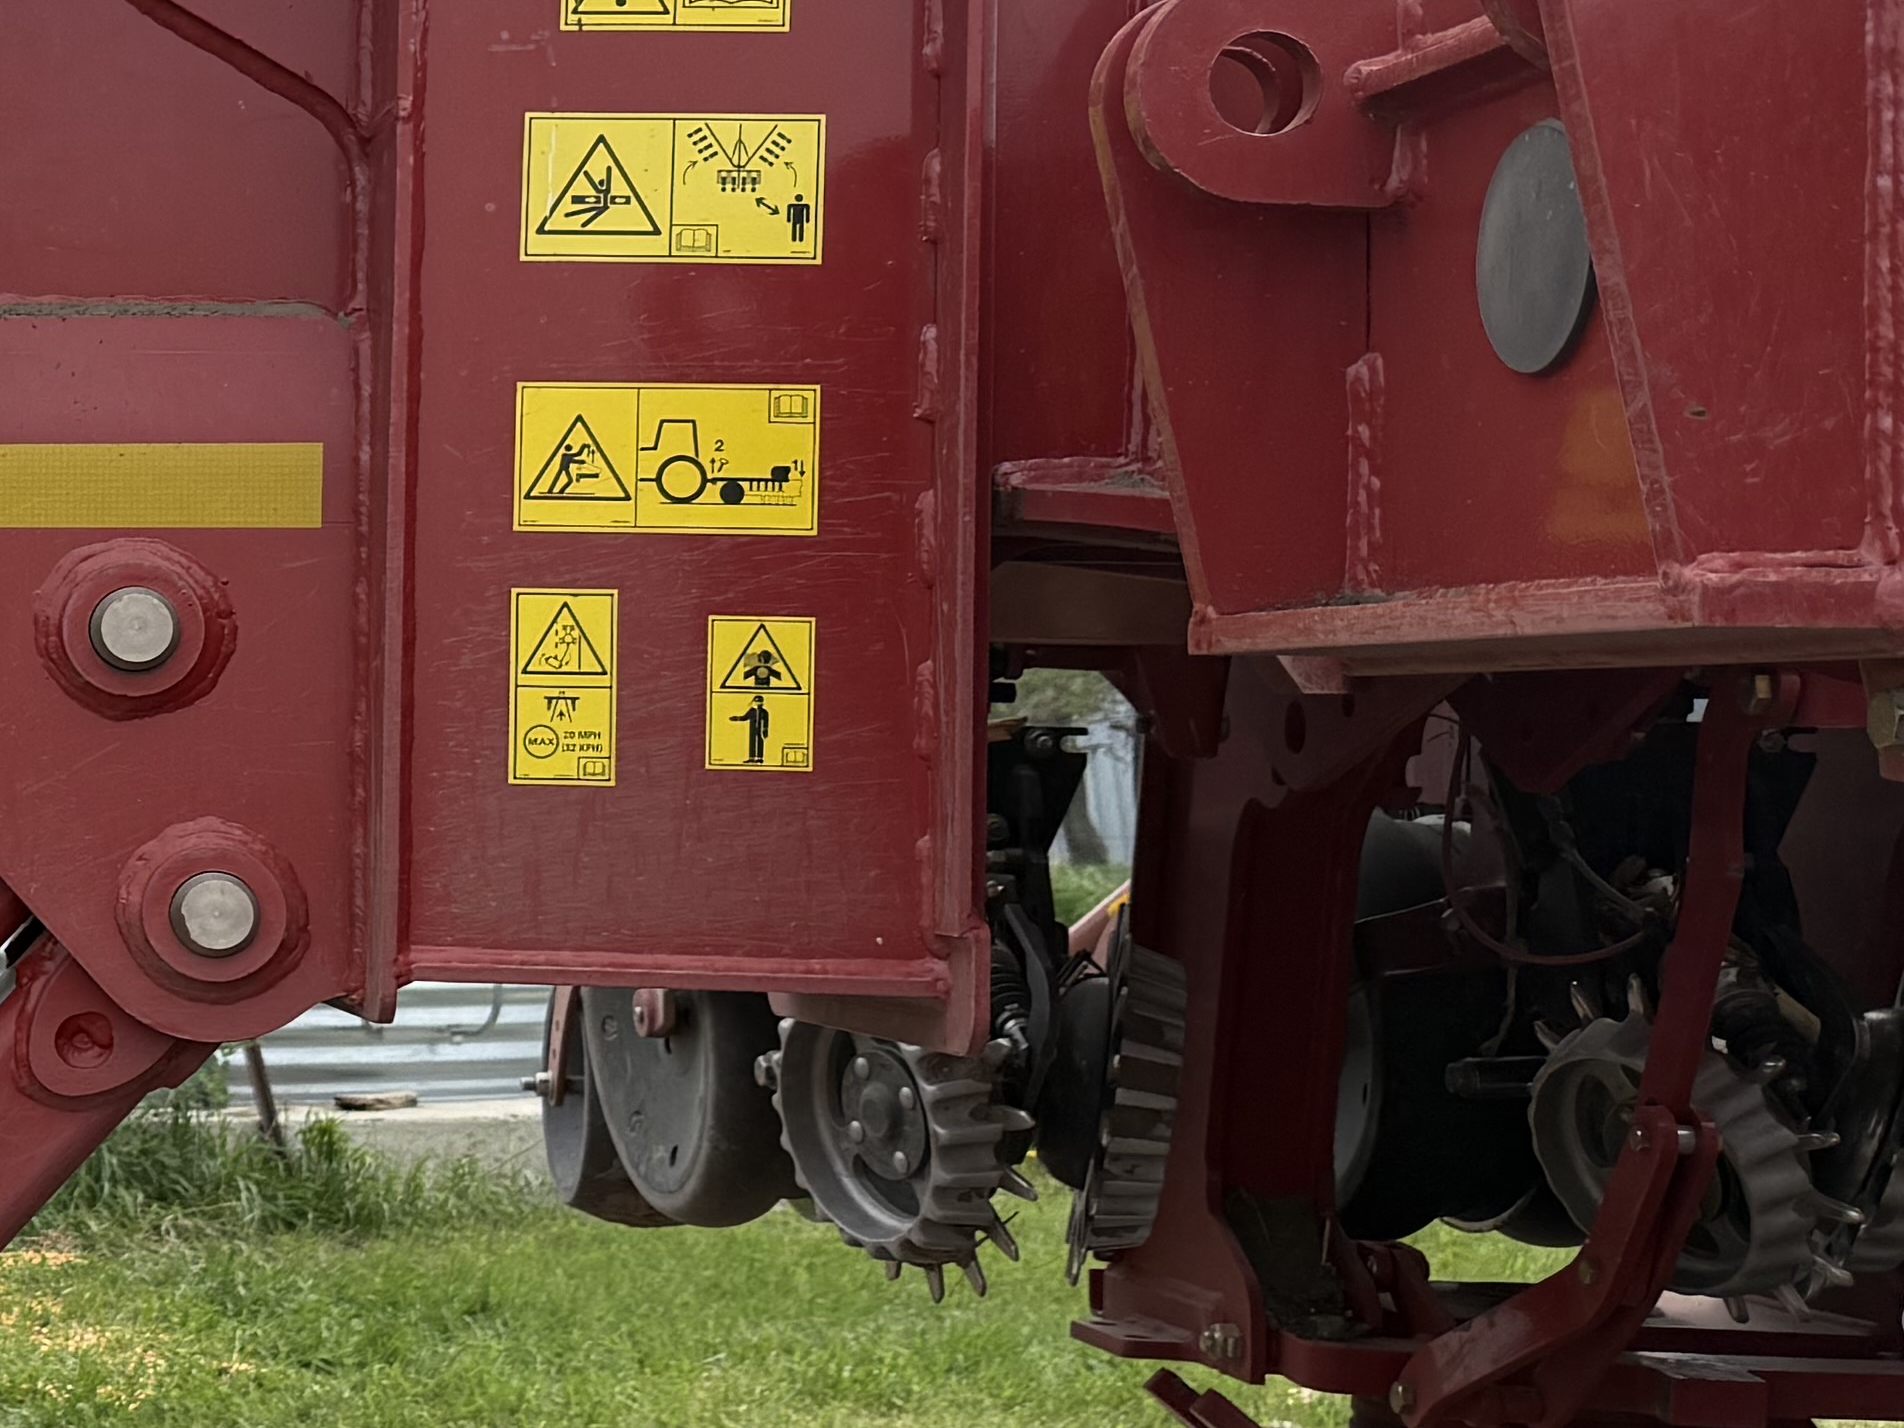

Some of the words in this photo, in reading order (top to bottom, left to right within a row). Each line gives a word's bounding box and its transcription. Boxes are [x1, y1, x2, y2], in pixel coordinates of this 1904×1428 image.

[714, 438, 725, 452] 2
[791, 459, 798, 471] 1
[577, 730, 601, 740] MPH
[527, 737, 555, 746] MAX
